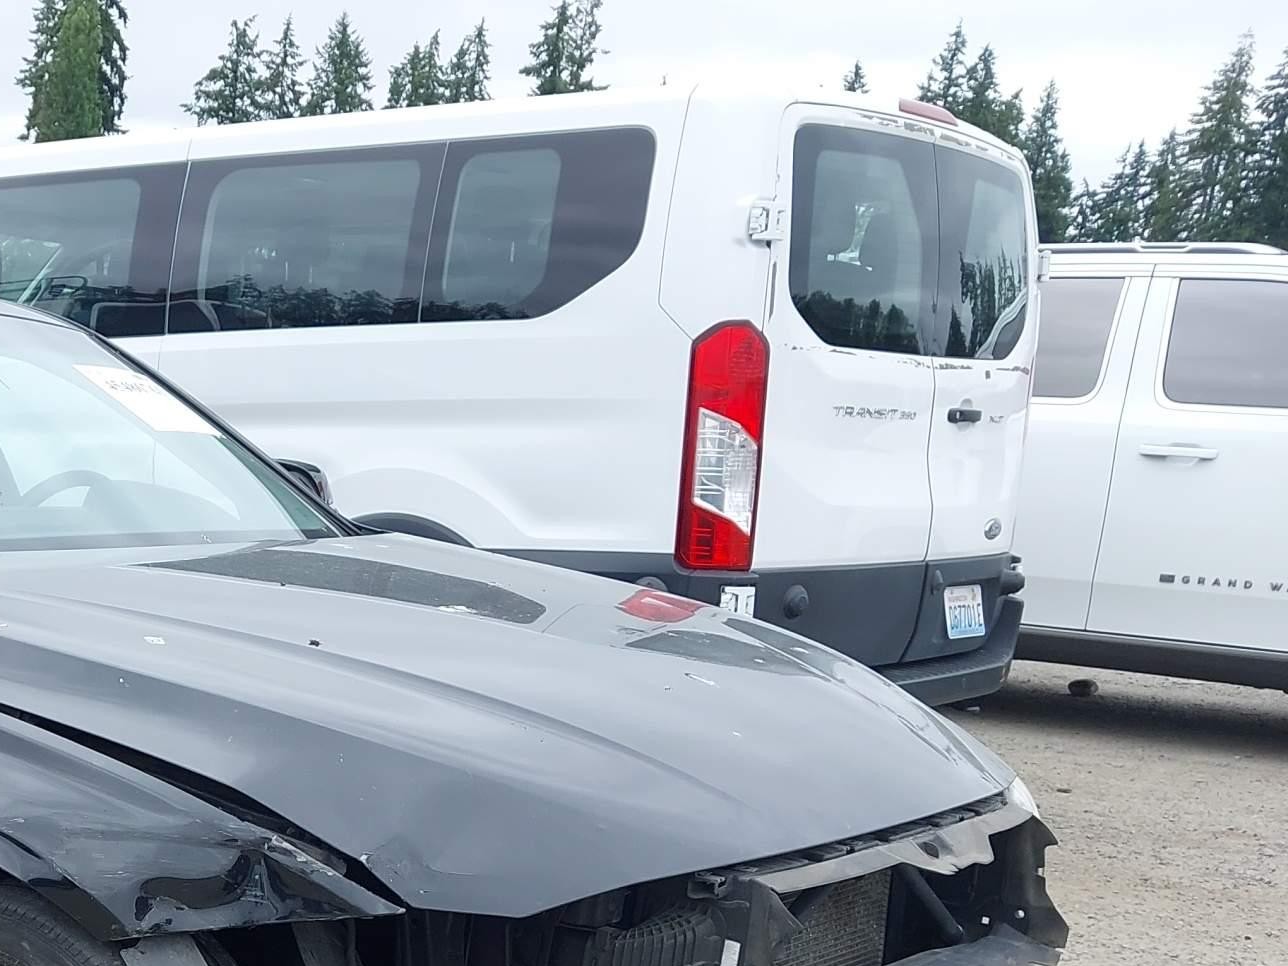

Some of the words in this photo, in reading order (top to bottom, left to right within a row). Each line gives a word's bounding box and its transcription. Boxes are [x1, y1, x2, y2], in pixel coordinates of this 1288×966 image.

[833, 405, 899, 420] TRANSIT
[1181, 575, 1254, 590] GRAND
[1269, 581, 1288, 593] W
